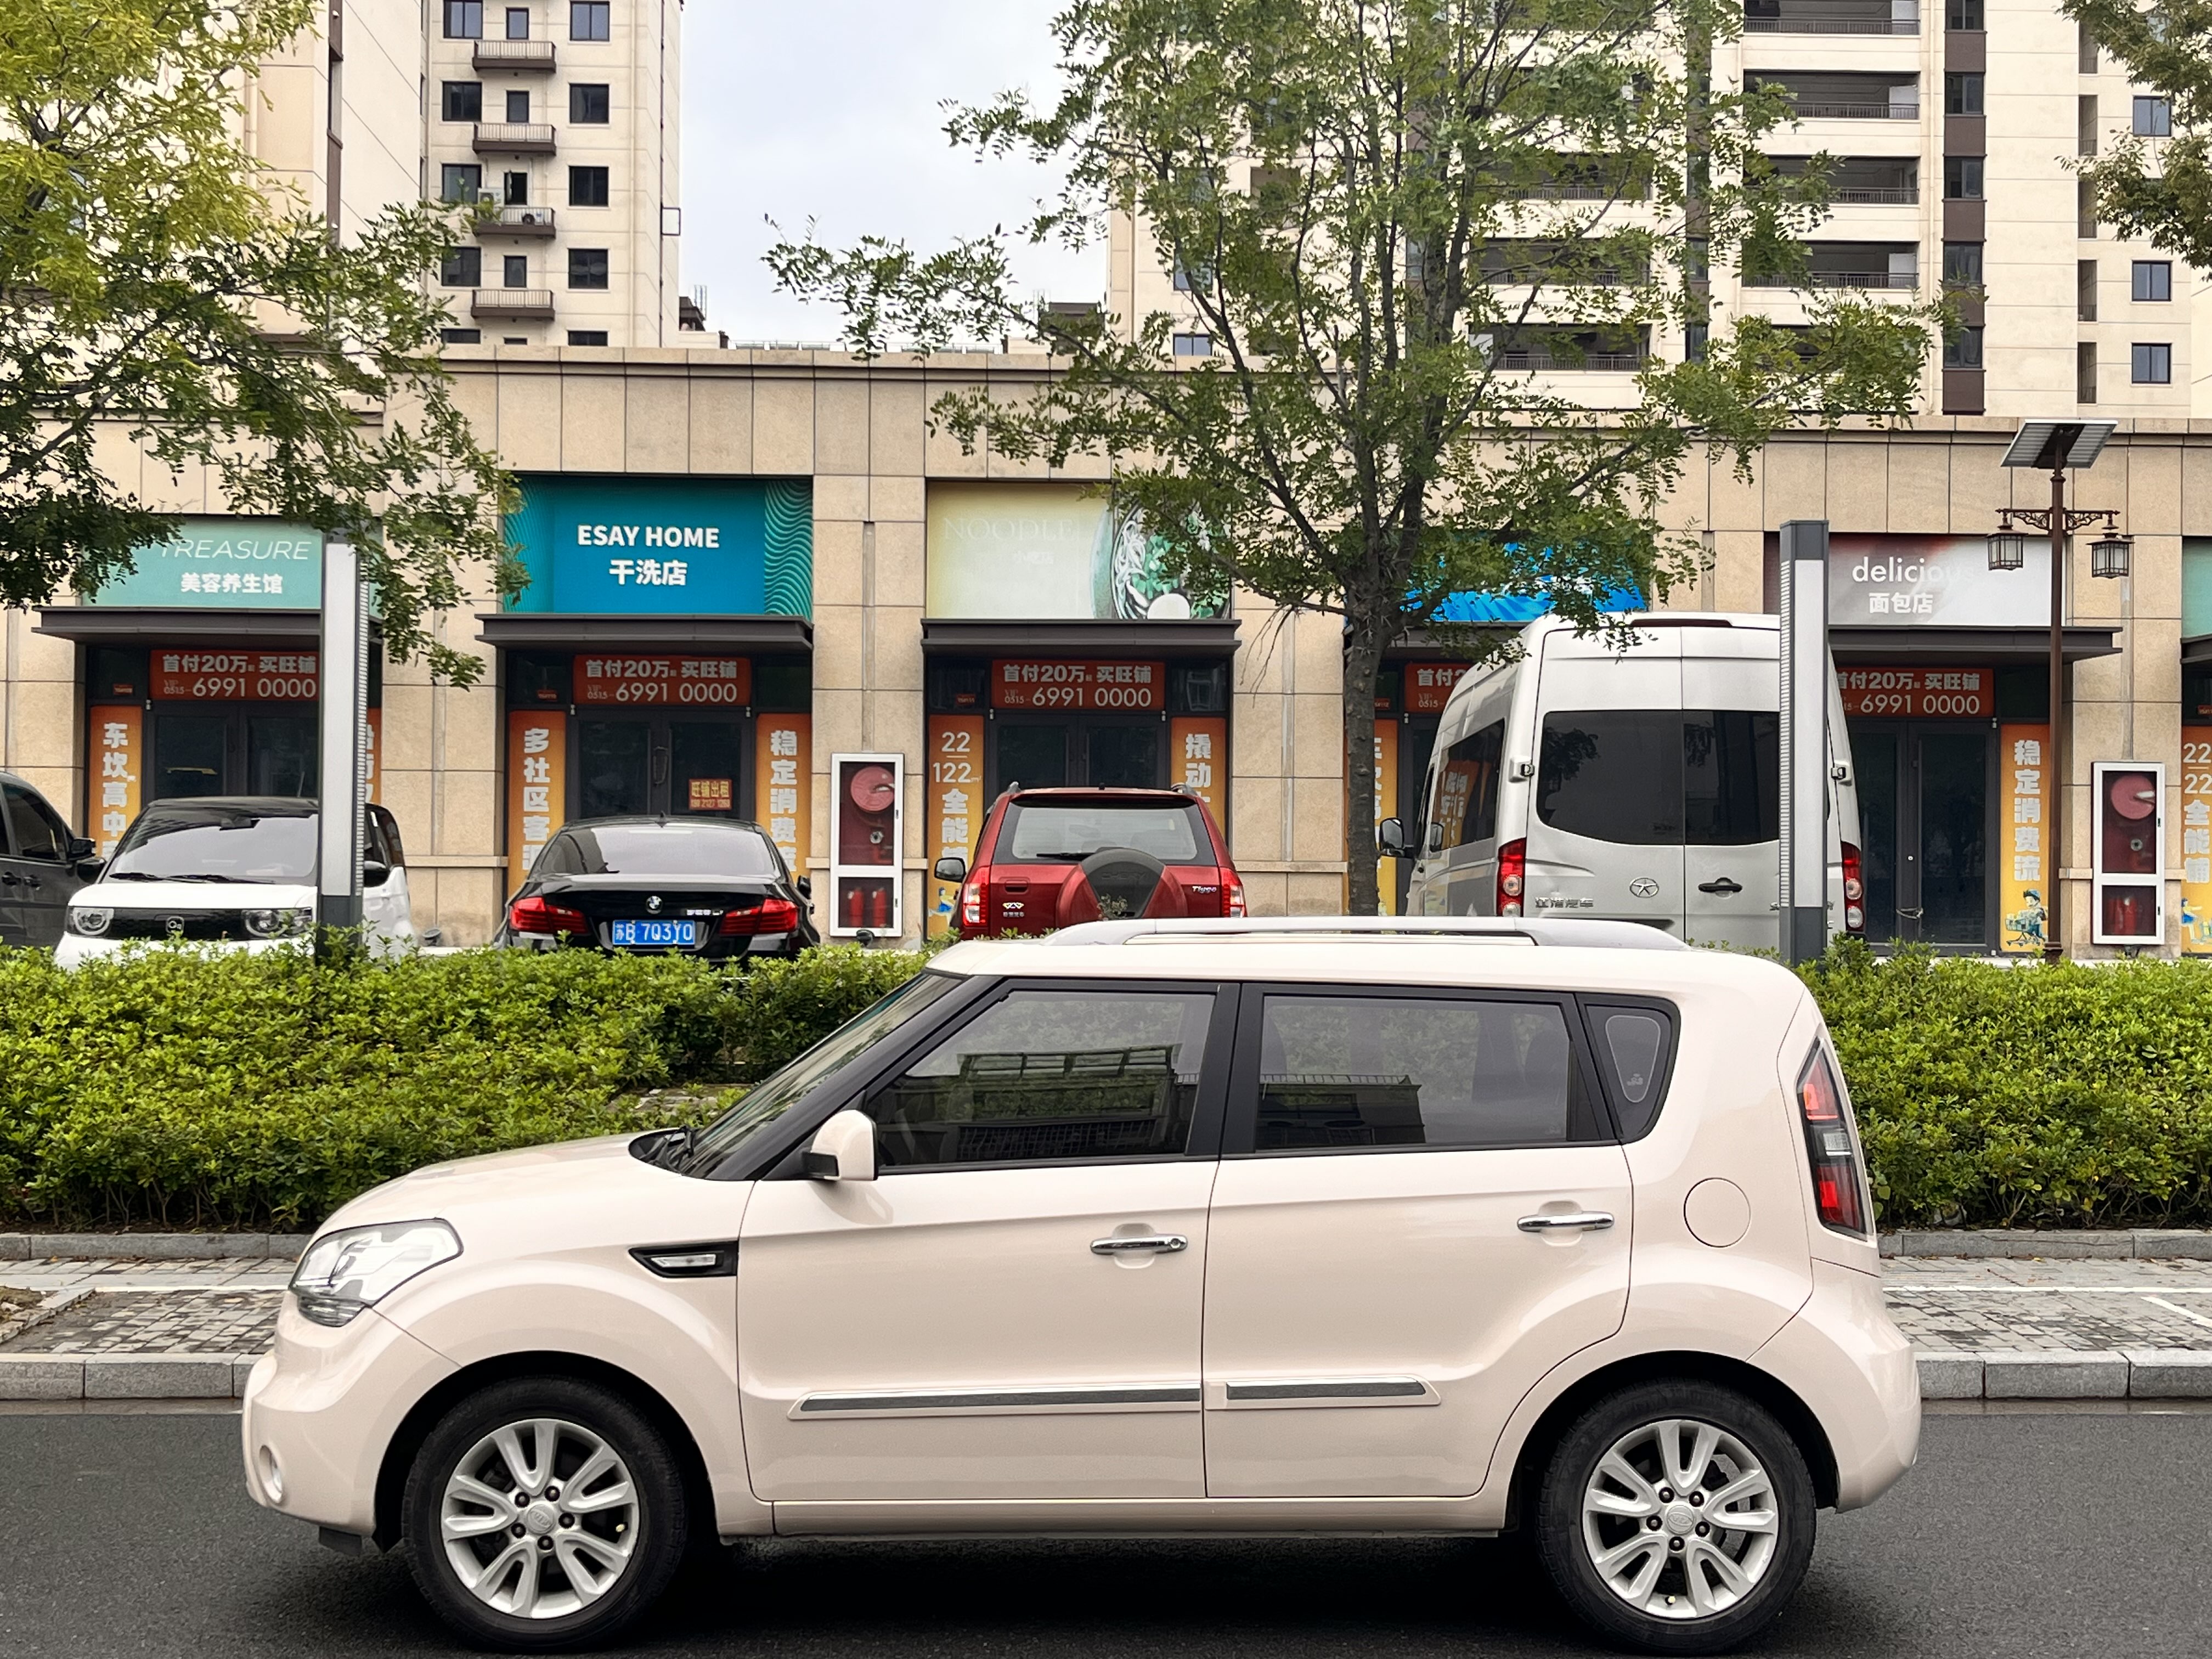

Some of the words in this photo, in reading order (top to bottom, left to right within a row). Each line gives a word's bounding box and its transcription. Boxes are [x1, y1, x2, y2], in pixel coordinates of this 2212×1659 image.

[578, 524, 640, 546] ESAY
[645, 526, 720, 548] HOME
[609, 558, 688, 585] 干洗店
[180, 572, 283, 594] 美容养生馆
[1869, 592, 1933, 613] 面包店
[259, 656, 317, 674] 买旺铺
[681, 661, 737, 679] 买旺铺
[1097, 665, 1152, 684] 买旺铺
[257, 679, 317, 698] 0000
[1925, 673, 1980, 691] 买旺铺
[679, 683, 737, 702] 0000
[1094, 688, 1152, 707] 0000
[1923, 695, 1980, 714] 0000
[941, 732, 970, 752] 22
[2183, 743, 2211, 763] 22
[1186, 733, 1211, 803] 撬动
[2015, 740, 2041, 881] 稳定消费流
